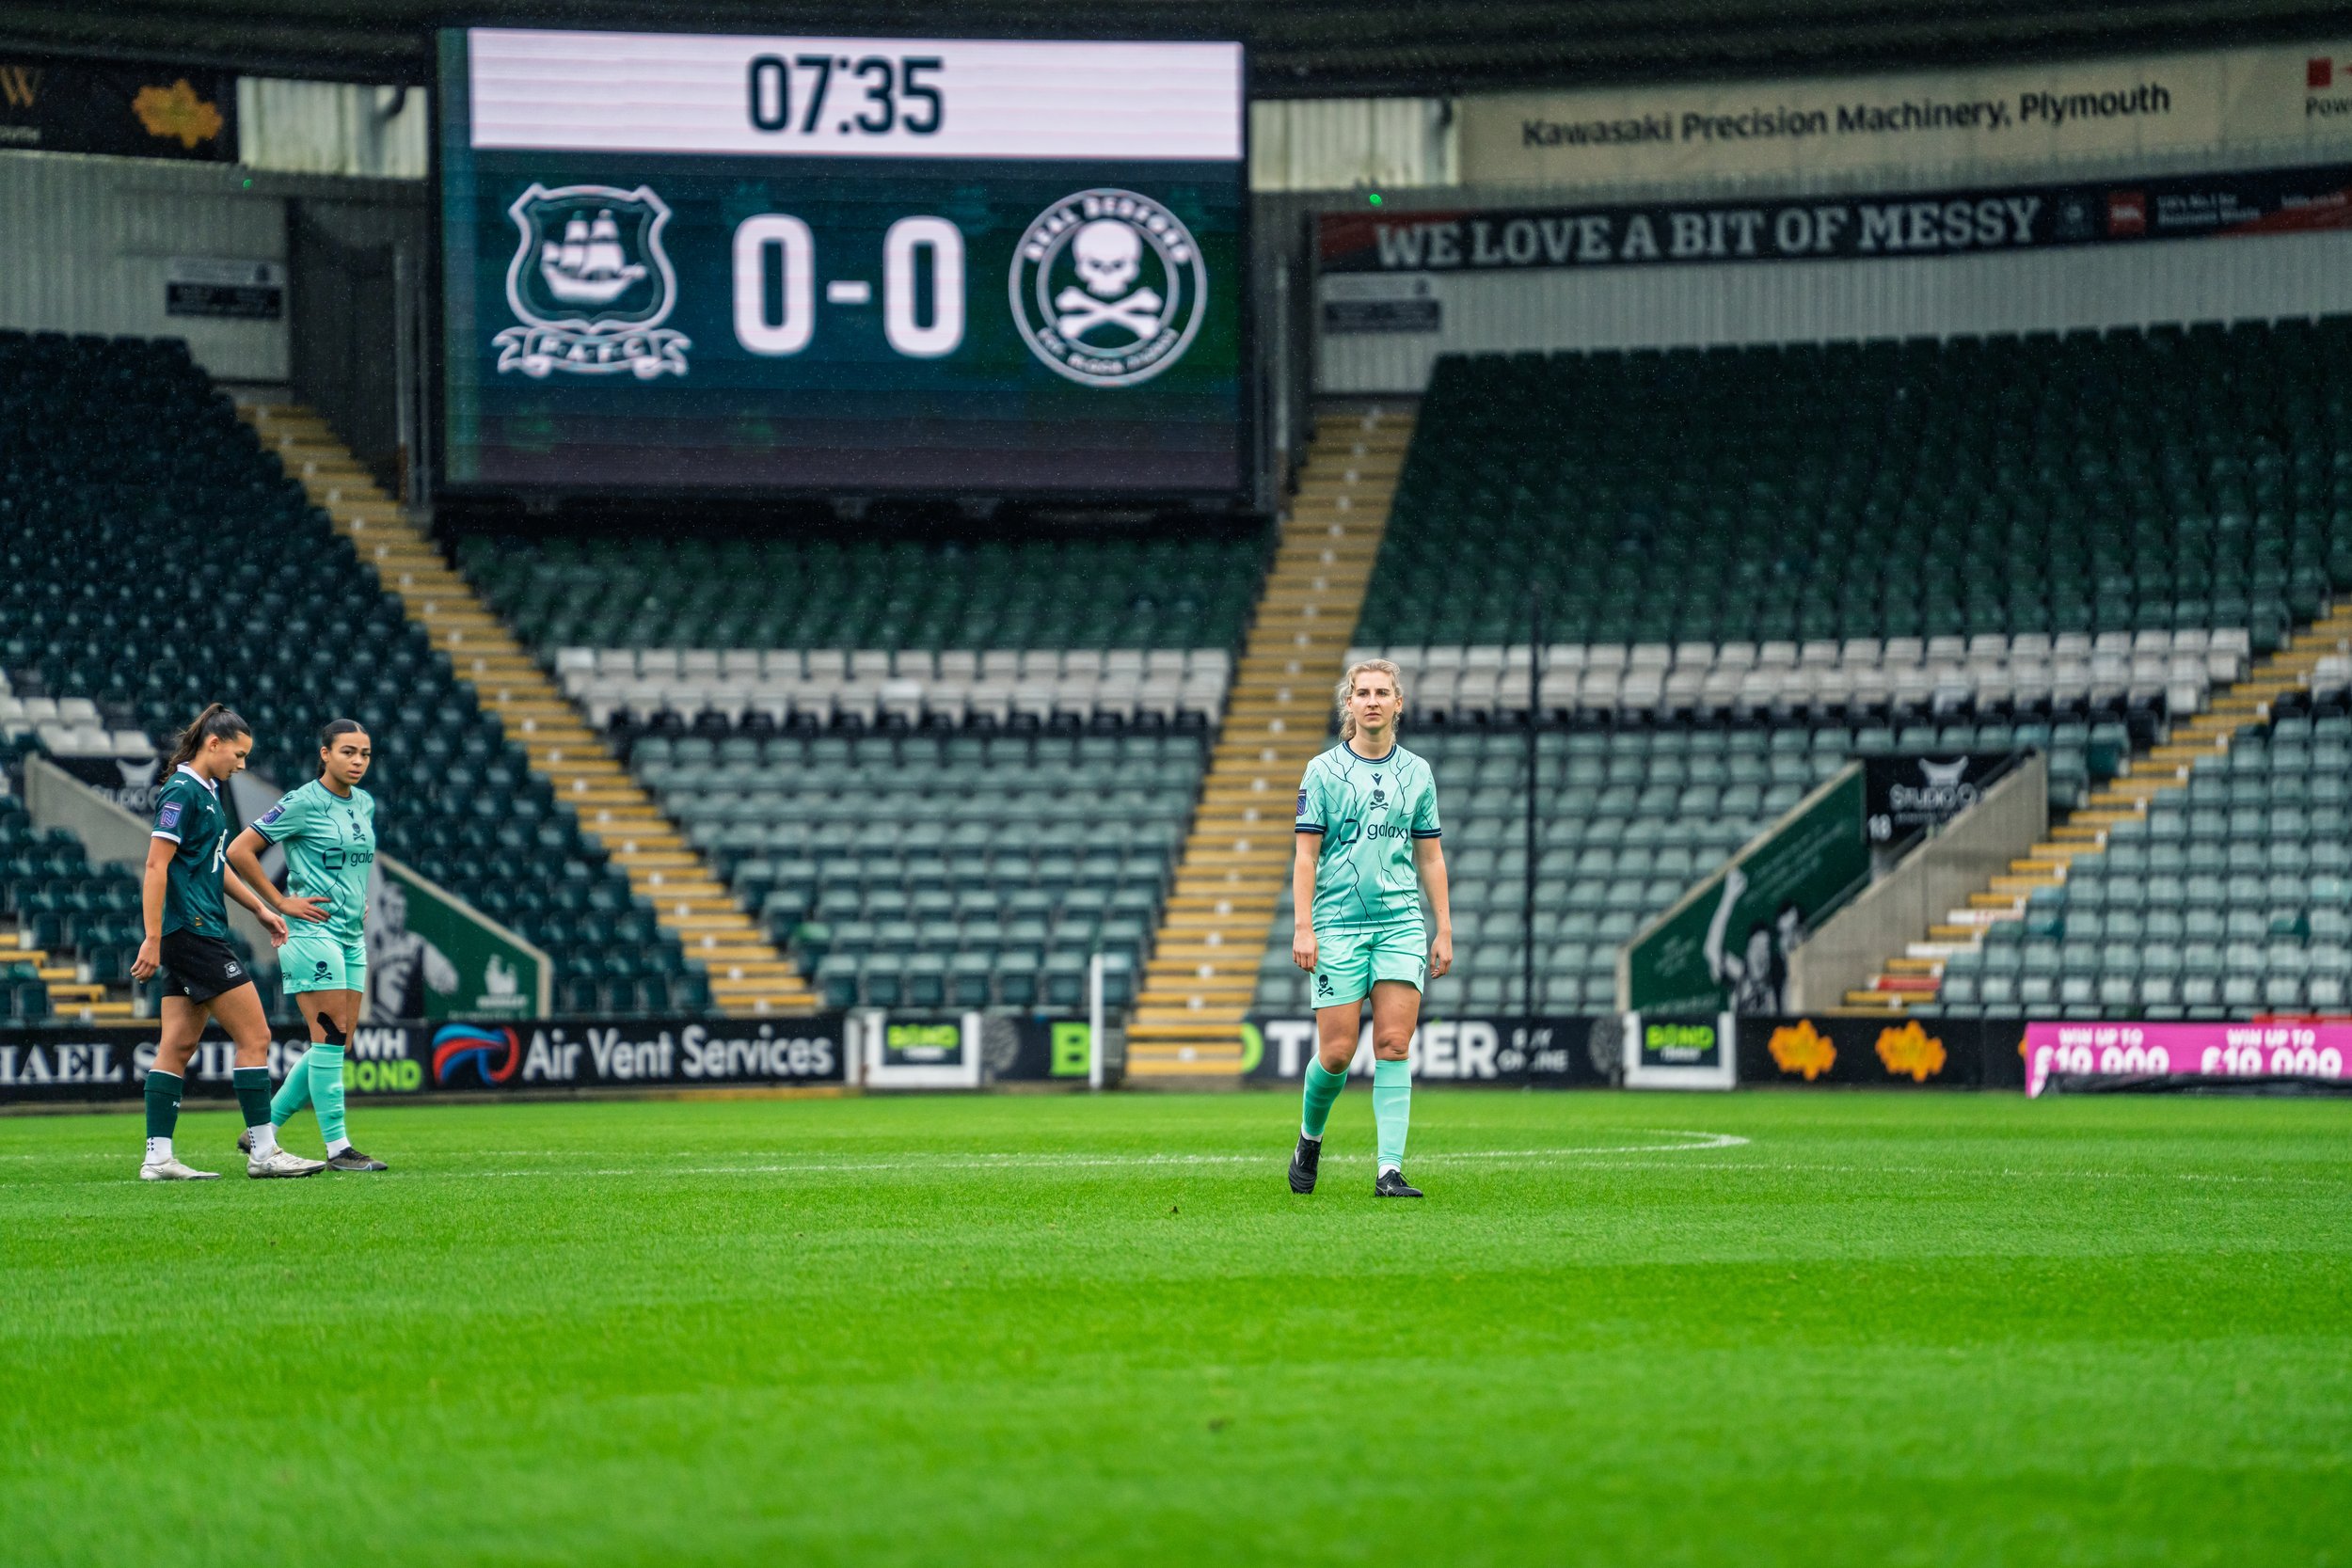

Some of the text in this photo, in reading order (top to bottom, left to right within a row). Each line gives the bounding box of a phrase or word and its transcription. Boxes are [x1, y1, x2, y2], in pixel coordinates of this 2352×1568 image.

[1521, 82, 2171, 148] Kawasaki Precision Machinery, Plymouth
[2306, 96, 2352, 118] Pow
[1375, 222, 1462, 267] WE
[1471, 215, 1613, 266] LOVE
[1621, 214, 1661, 260] A
[1670, 209, 1766, 257] BIT
[1774, 204, 1849, 252] OF
[1856, 195, 2042, 250] MESSY
[1366, 820, 1409, 845] galaxy
[2058, 1028, 2144, 1046] WIN UP TO
[2227, 1028, 2315, 1046] WIN UP TO
[521, 1024, 834, 1081] Air Vent Services
